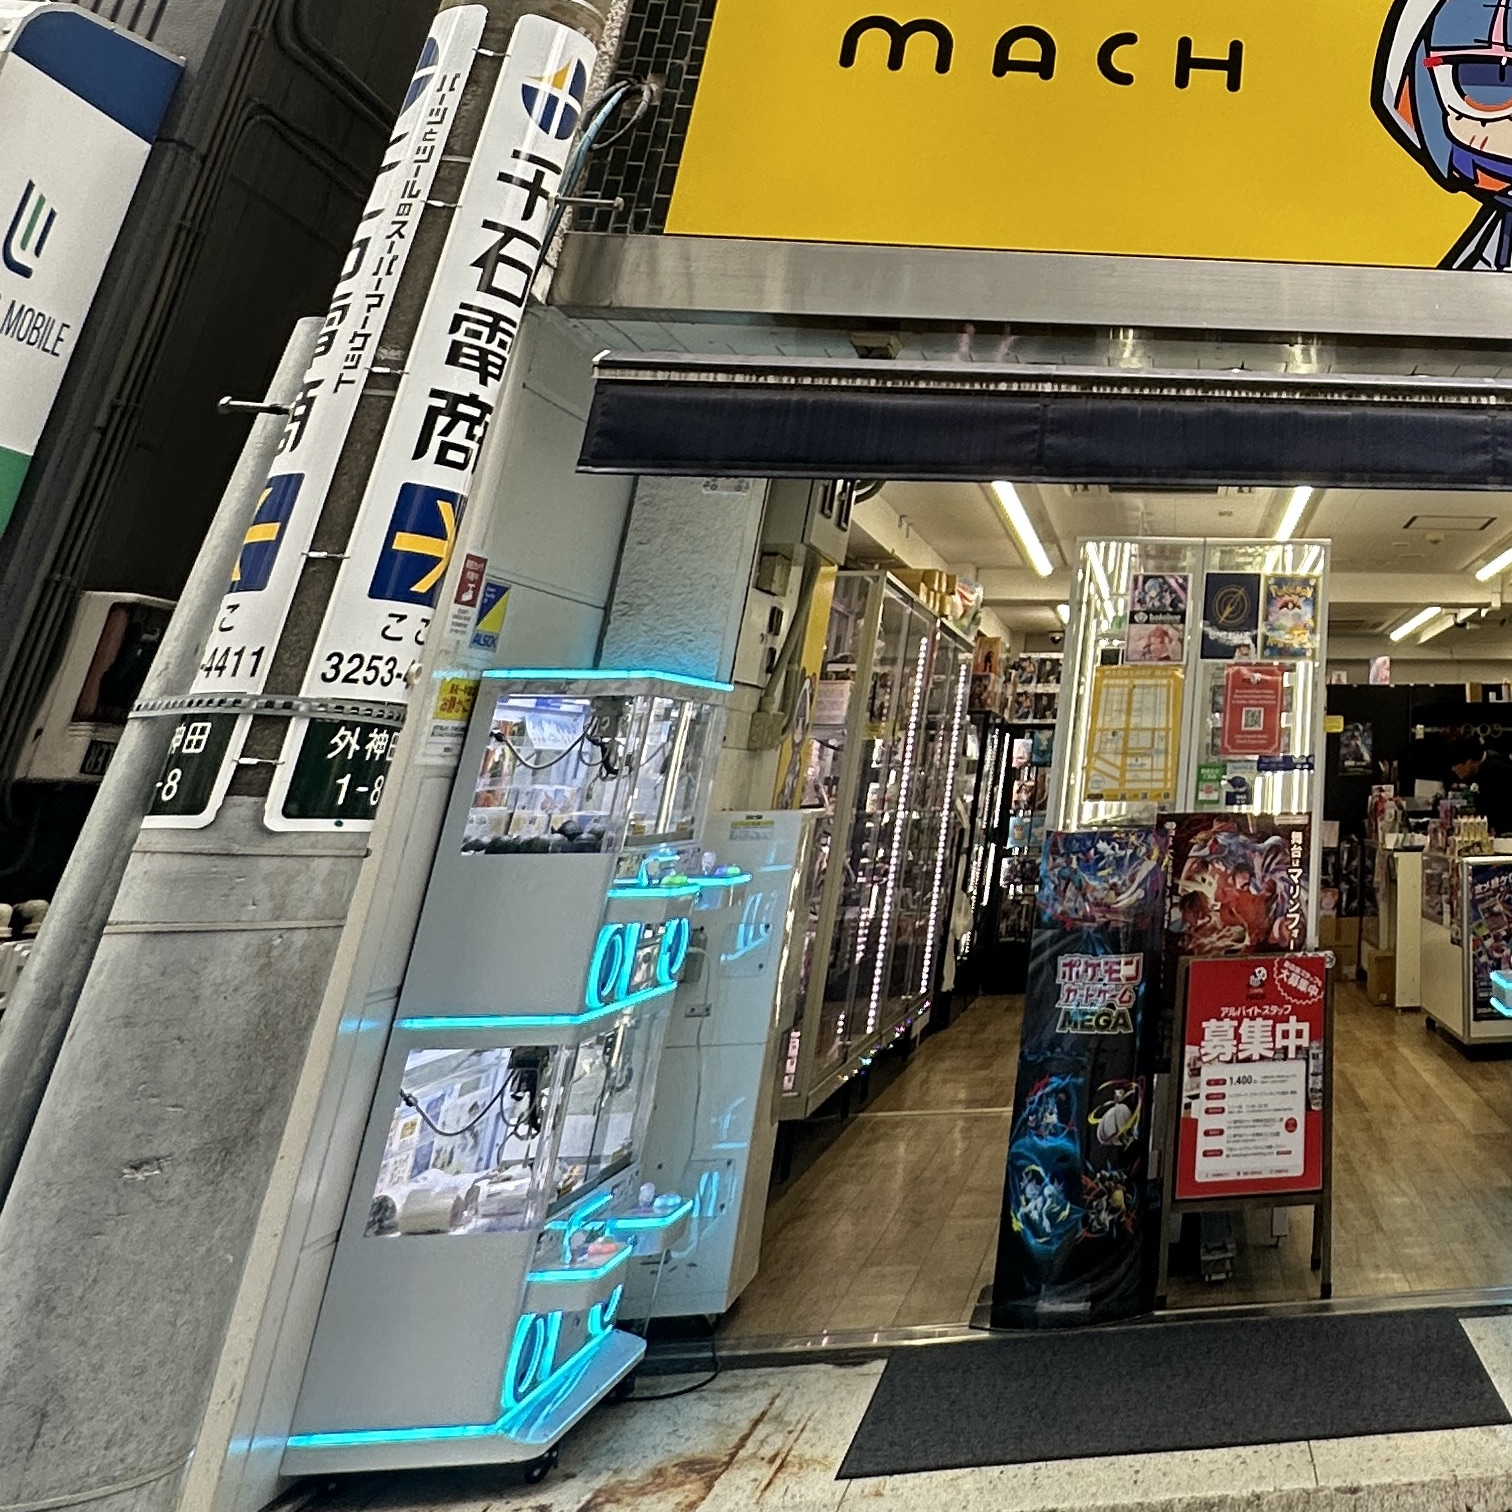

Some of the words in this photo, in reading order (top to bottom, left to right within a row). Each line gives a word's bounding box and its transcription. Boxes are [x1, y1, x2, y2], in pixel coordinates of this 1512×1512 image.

[839, 14, 1245, 93] MACH
[2, 299, 71, 358] MOBILE
[411, 148, 563, 474] 千石電商
[1060, 958, 1141, 983] ポケモン
[1058, 1009, 1133, 1031] MEGA
[1220, 1004, 1292, 1017] アルバイトスタッフ
[1200, 1015, 1310, 1063] 募集中
